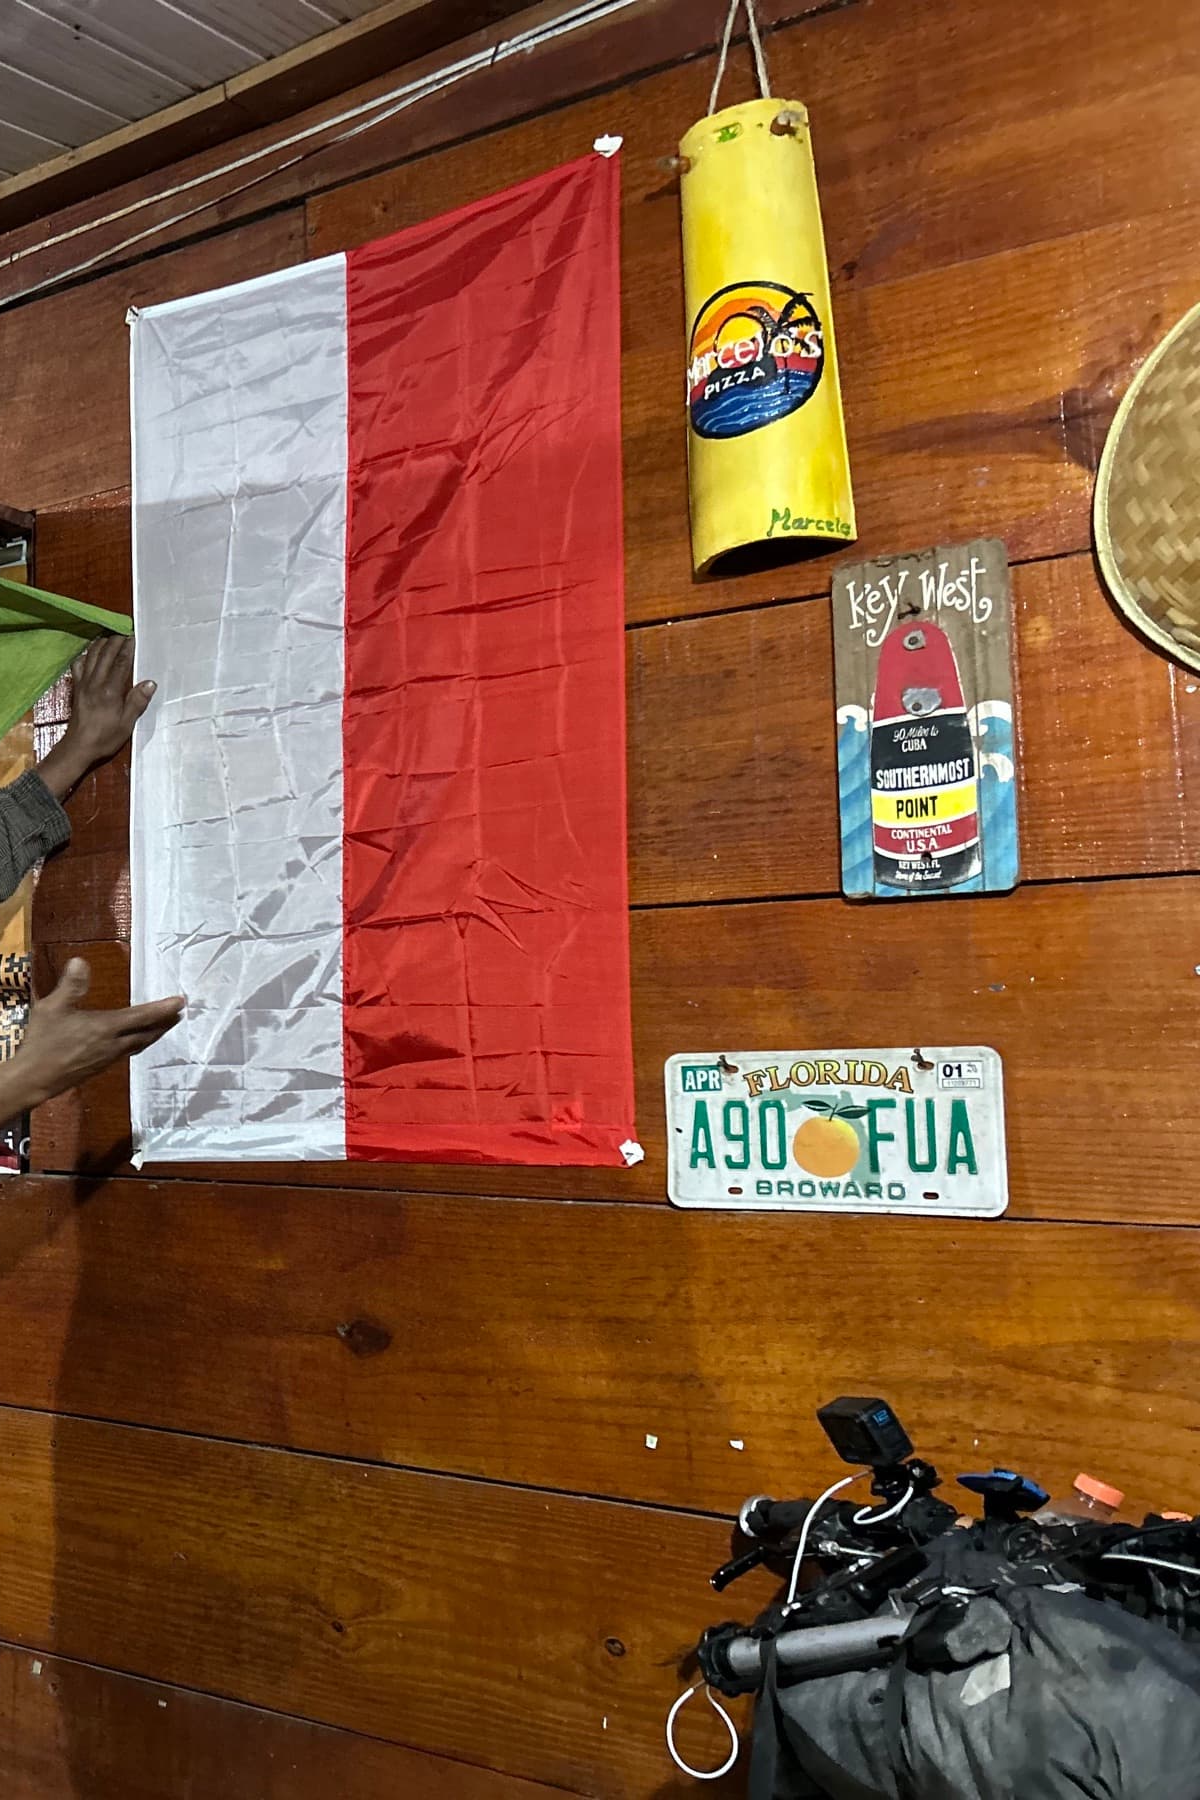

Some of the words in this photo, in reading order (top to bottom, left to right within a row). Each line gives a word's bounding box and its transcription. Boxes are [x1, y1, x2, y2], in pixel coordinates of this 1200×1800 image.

[704, 366, 766, 400] PIZZA
[766, 507, 851, 537] Marcelo
[846, 570, 910, 647] Key
[918, 557, 993, 623] West
[901, 738, 927, 752] CUBA
[875, 757, 970, 789] SOUTHERNMOST
[896, 795, 938, 820] POINT
[891, 824, 953, 840] CONTINENTAL
[684, 1069, 721, 1091] APR
[743, 1060, 915, 1097] FLORIDA
[942, 1063, 962, 1078] 01
[689, 1099, 787, 1170] A90
[867, 1098, 978, 1175] FUA
[756, 1179, 906, 1200] BROWARD
